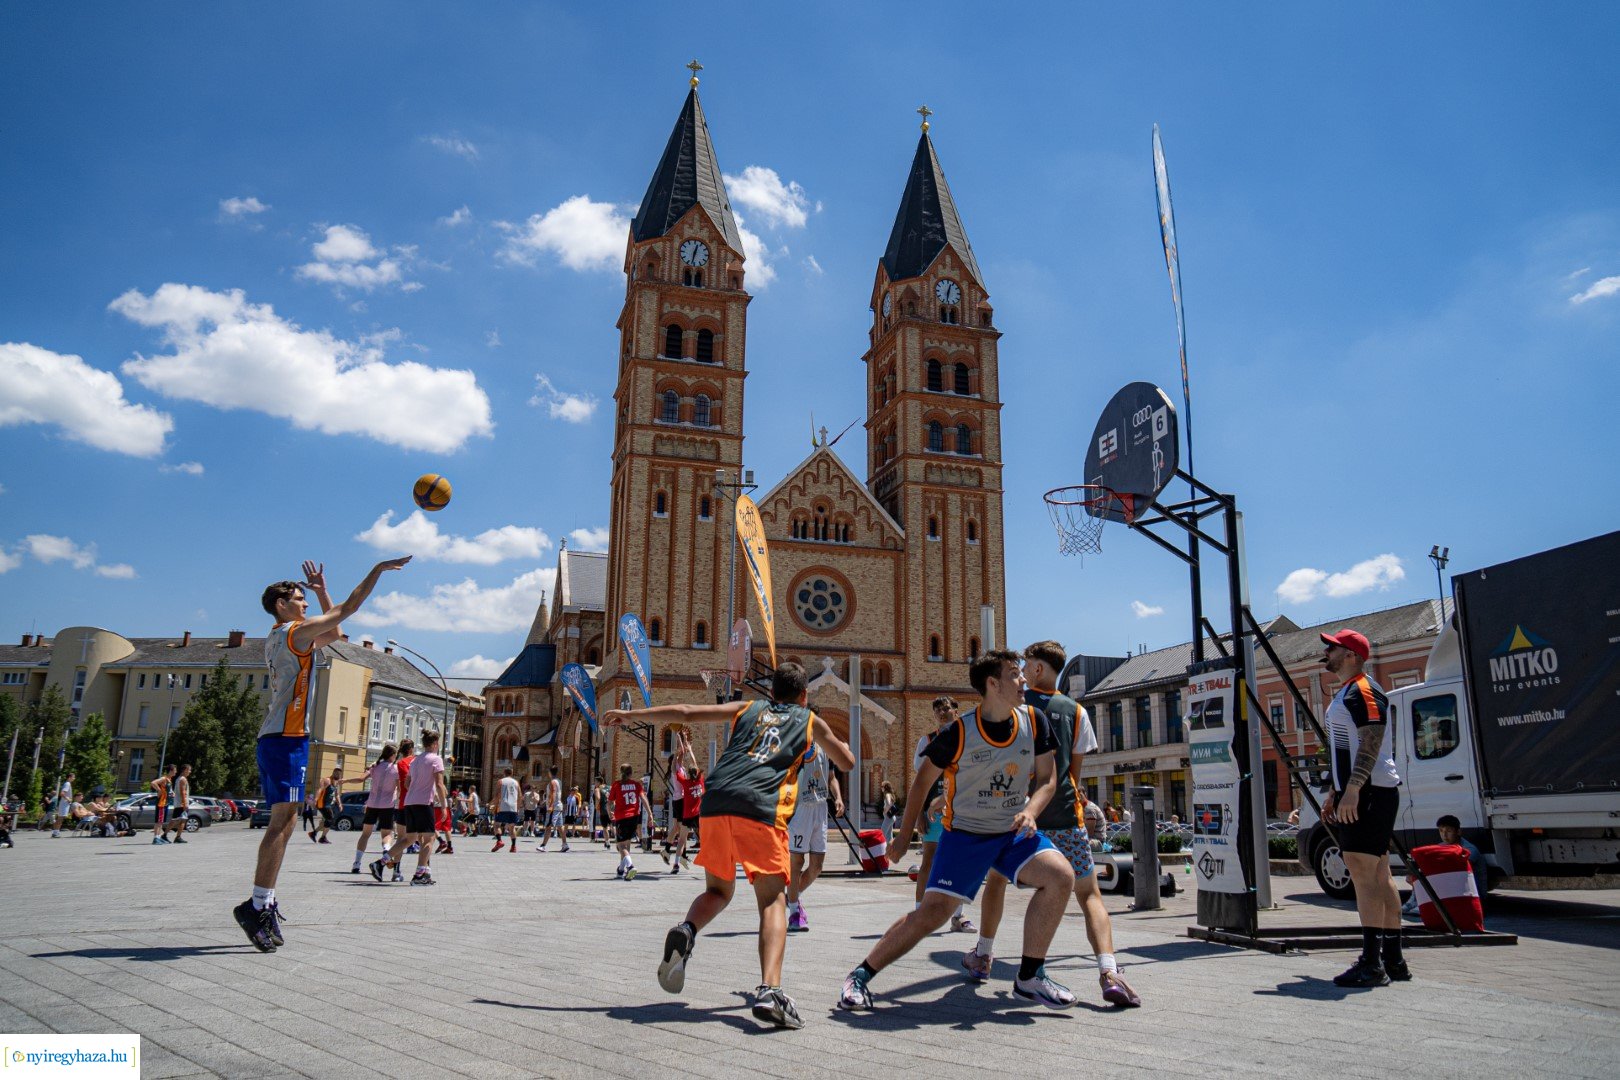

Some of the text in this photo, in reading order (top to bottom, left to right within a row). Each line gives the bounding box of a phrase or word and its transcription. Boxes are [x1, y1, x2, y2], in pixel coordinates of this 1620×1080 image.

[1156, 415, 1163, 431] 6
[1489, 648, 1558, 681] MITKO
[1493, 676, 1560, 692] for events
[1498, 709, 1565, 726] www.mitko.hu
[1192, 748, 1211, 758] MVM
[623, 792, 637, 805] 13
[794, 835, 803, 848] 12
